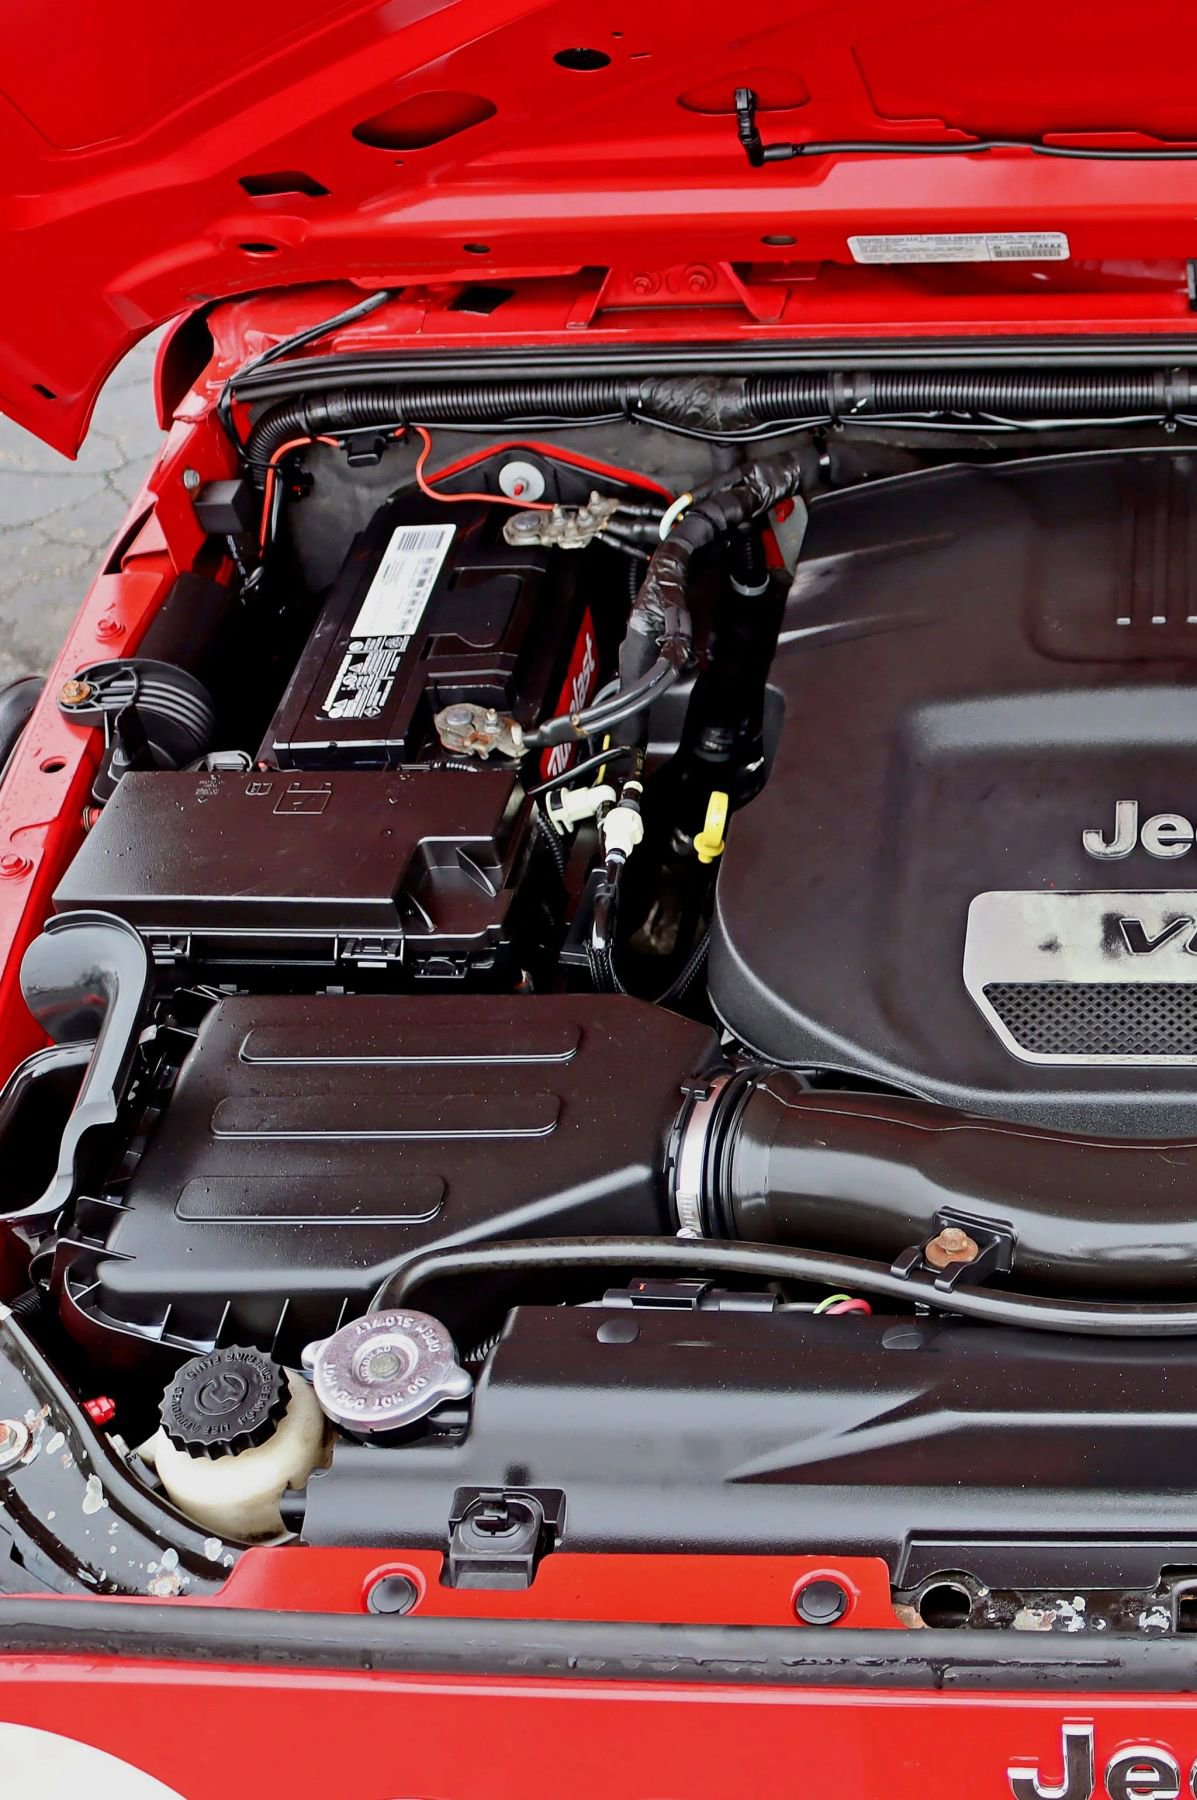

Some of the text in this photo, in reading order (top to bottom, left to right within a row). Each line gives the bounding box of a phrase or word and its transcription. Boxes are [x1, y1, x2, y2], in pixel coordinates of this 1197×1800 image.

[416, 1323, 442, 1354] OPEN
[186, 1355, 222, 1380] FLUID
[407, 1376, 429, 1395] DO
[238, 1385, 273, 1426] POWER
[373, 1392, 405, 1410] NOT
